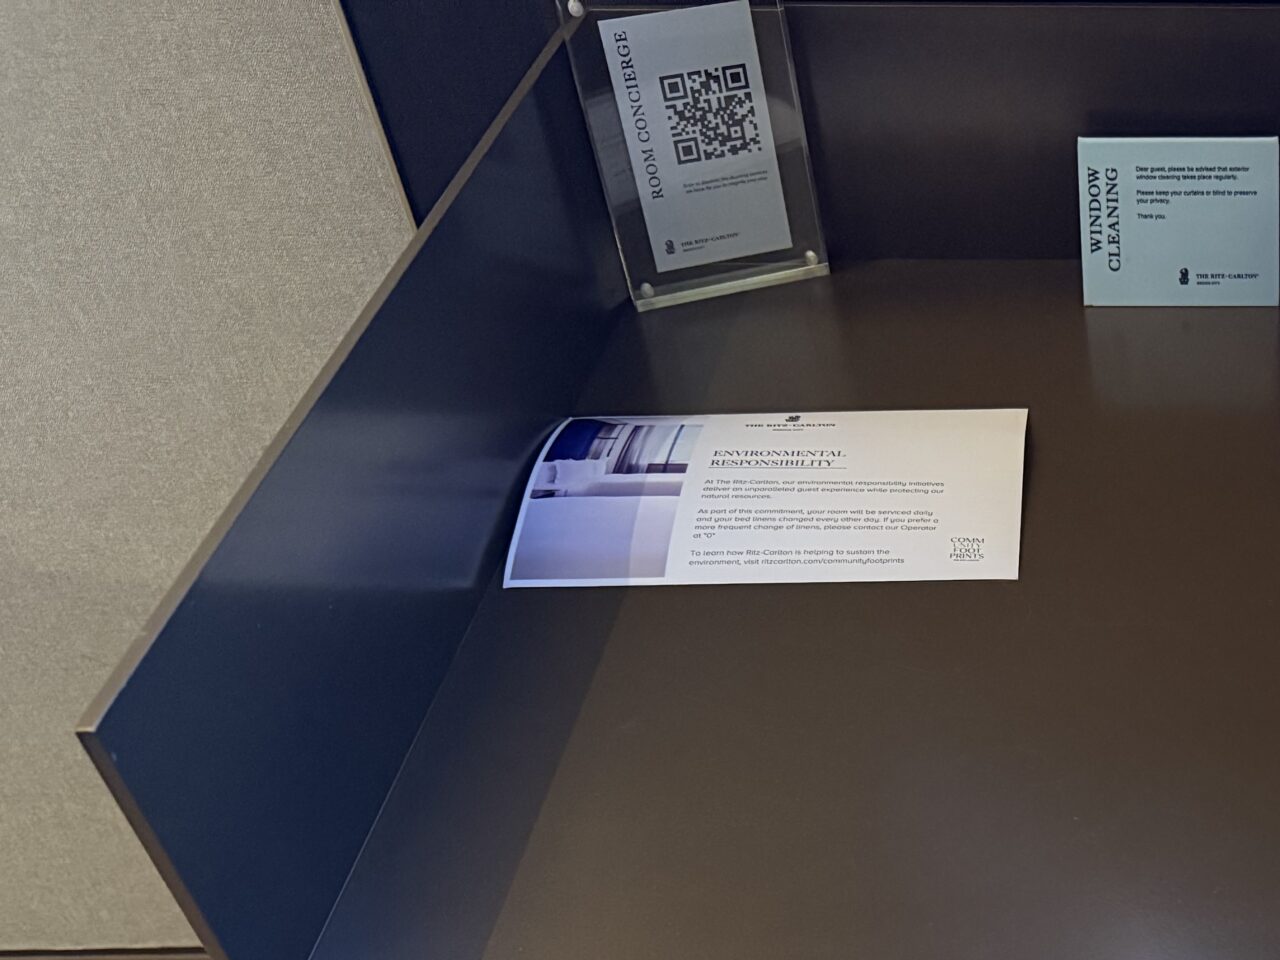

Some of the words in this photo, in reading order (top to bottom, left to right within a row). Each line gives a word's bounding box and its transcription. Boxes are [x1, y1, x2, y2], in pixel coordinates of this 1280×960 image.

[613, 30, 650, 144] CONCIERGE
[641, 147, 664, 200] ROOM
[1087, 166, 1103, 254] WINDOW
[1105, 167, 1121, 272] CLEANING
[709, 459, 836, 467] RESPONSIBILITY
[712, 449, 847, 458] ENVIRONMENTAL
[803, 549, 834, 557] helping
